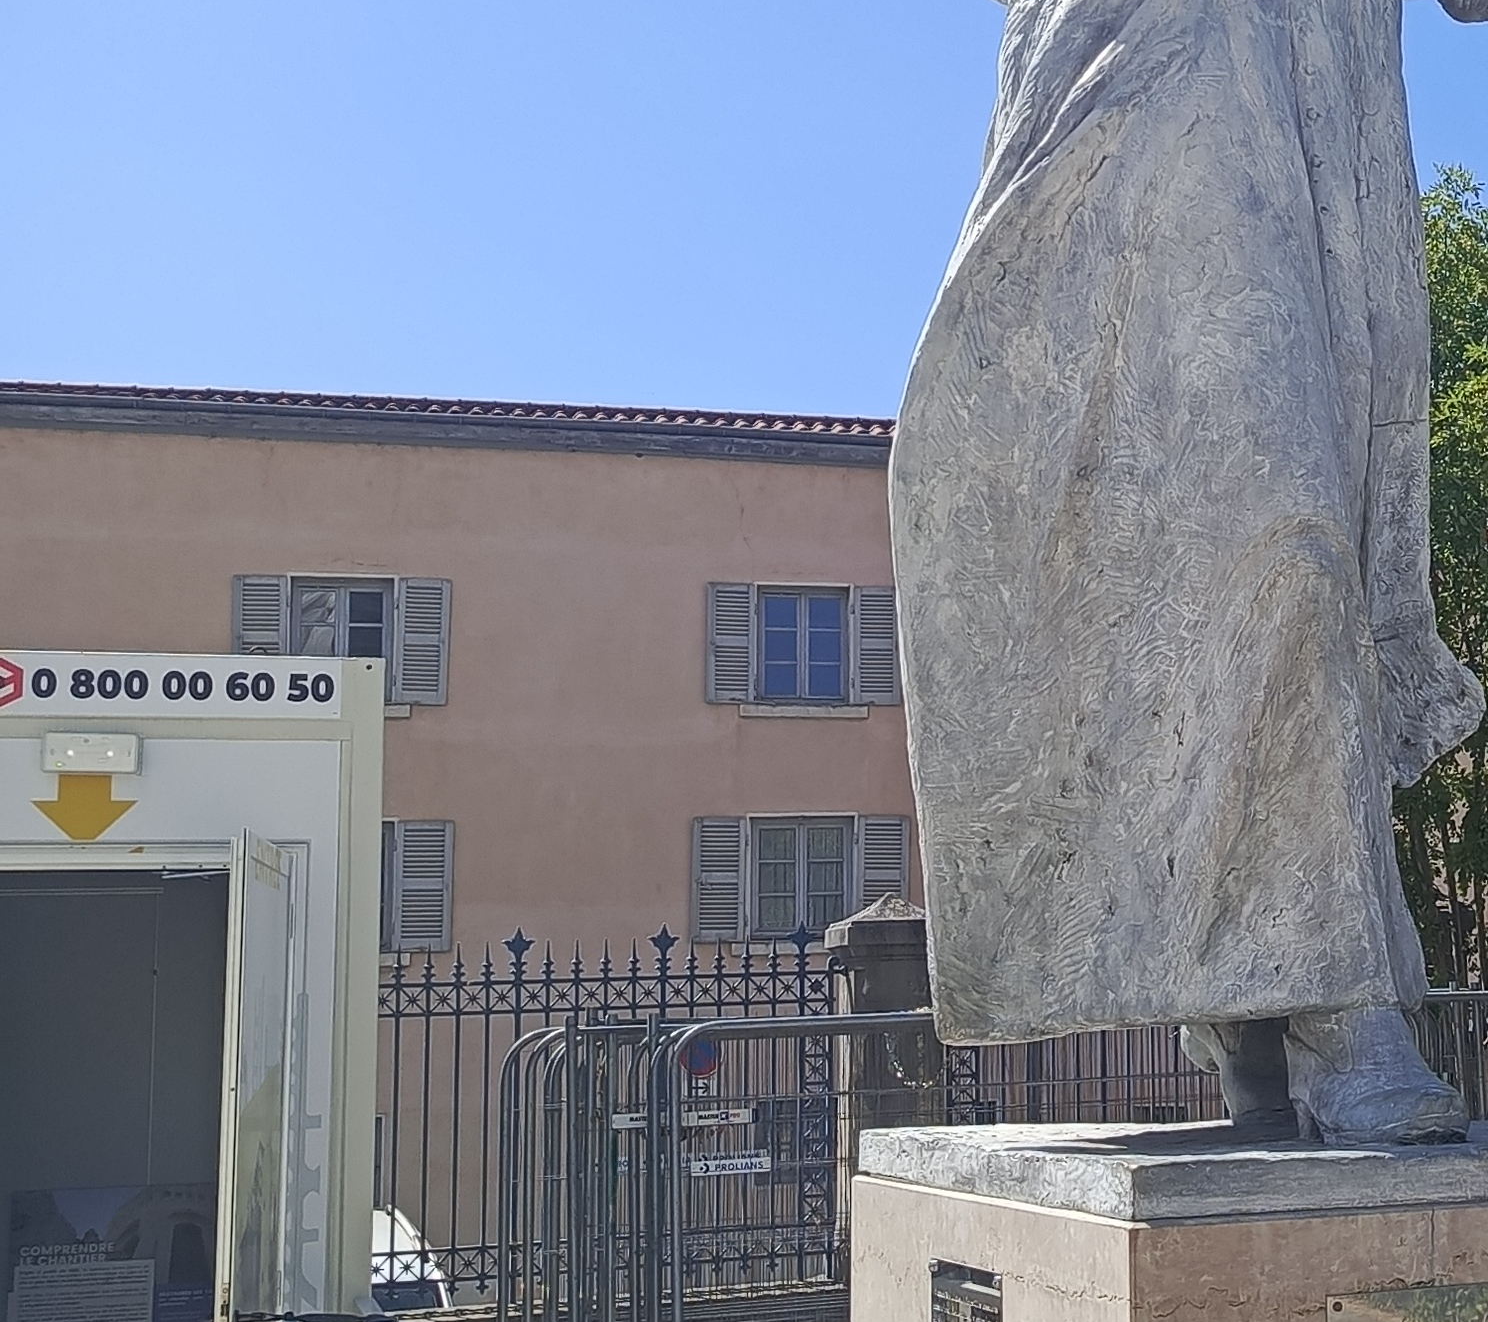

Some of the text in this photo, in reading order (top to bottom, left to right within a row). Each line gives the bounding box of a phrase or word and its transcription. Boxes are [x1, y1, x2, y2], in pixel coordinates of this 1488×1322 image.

[31, 668, 335, 703] 0 800 00 60 50
[715, 1161, 763, 1171] PROLIANS
[20, 1242, 115, 1257] COMPRENDRE
[20, 1253, 107, 1266] LE CHANTIER
